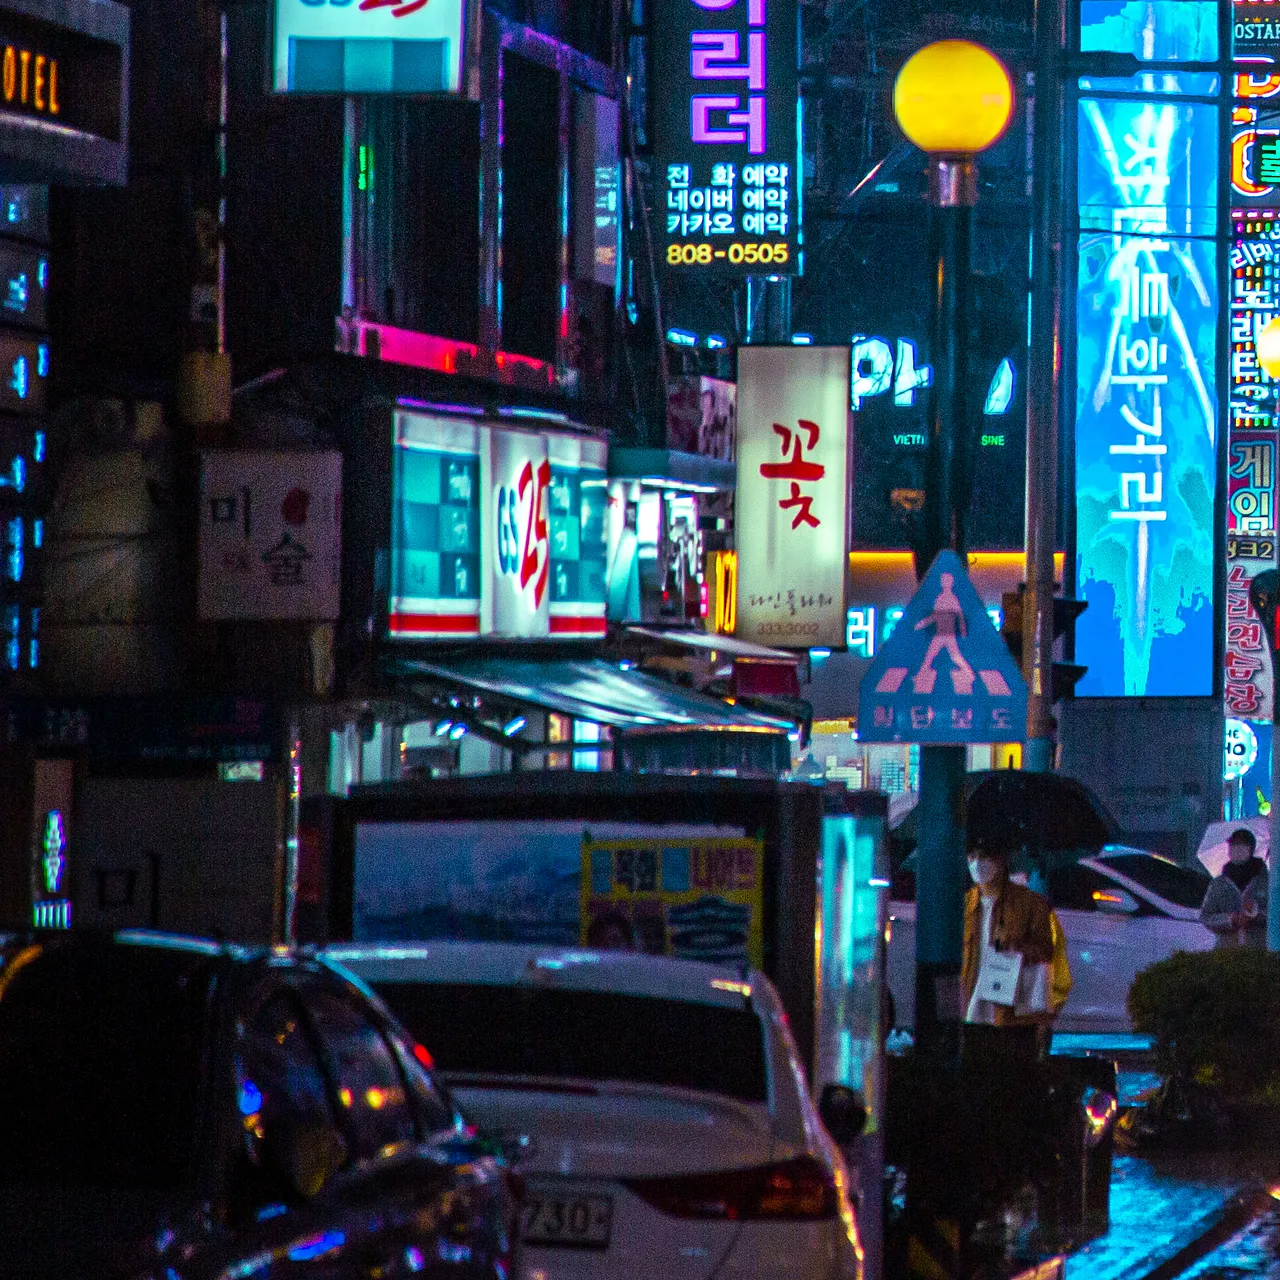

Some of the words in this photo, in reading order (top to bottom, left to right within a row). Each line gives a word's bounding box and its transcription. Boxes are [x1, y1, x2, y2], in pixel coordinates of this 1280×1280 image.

[743, 164, 788, 187] 예약
[667, 189, 735, 211] 네이버
[743, 189, 788, 211] 예약
[667, 212, 735, 235] 카카오
[743, 212, 788, 234] 예약
[667, 242, 789, 264] 808-0505
[760, 420, 824, 529] 꽃
